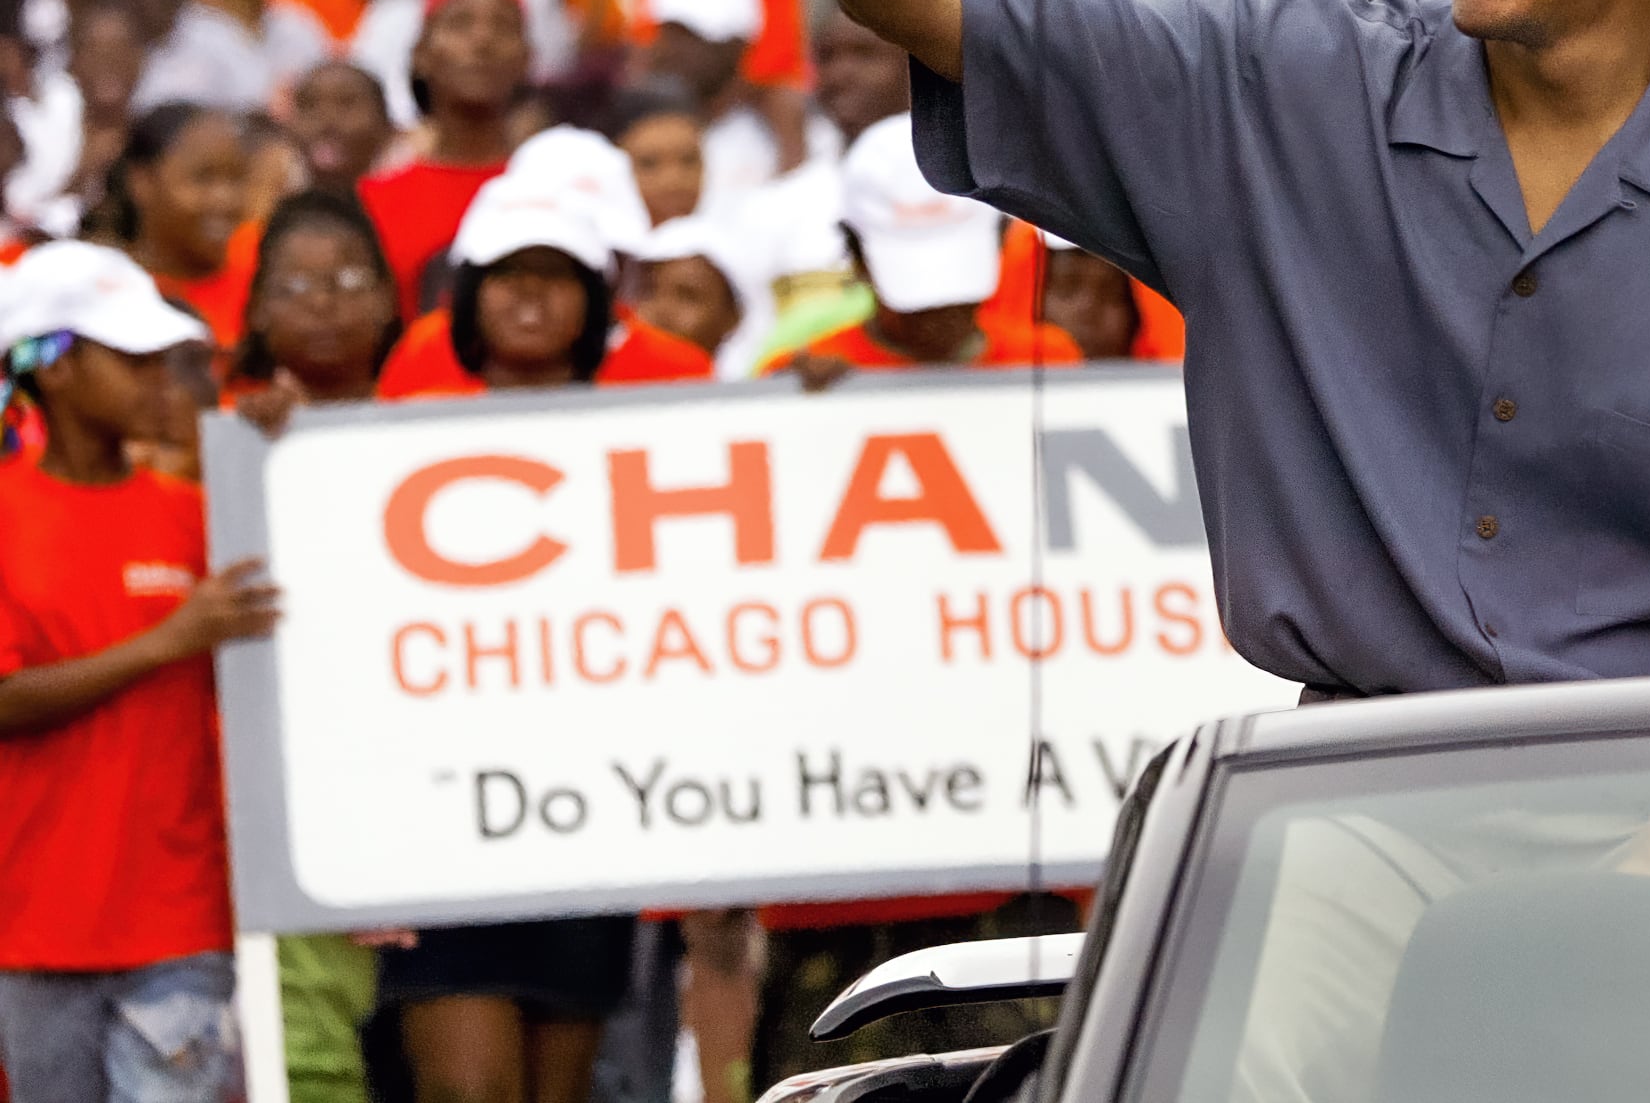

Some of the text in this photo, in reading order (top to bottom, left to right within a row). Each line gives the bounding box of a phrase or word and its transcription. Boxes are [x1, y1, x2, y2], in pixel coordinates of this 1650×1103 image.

[380, 426, 1206, 589] CHAN
[390, 580, 1235, 698] CHICAGO HOUS
[612, 751, 764, 830] You
[794, 742, 985, 819] Have
[1022, 734, 1075, 810] A
[1090, 734, 1165, 800] V
